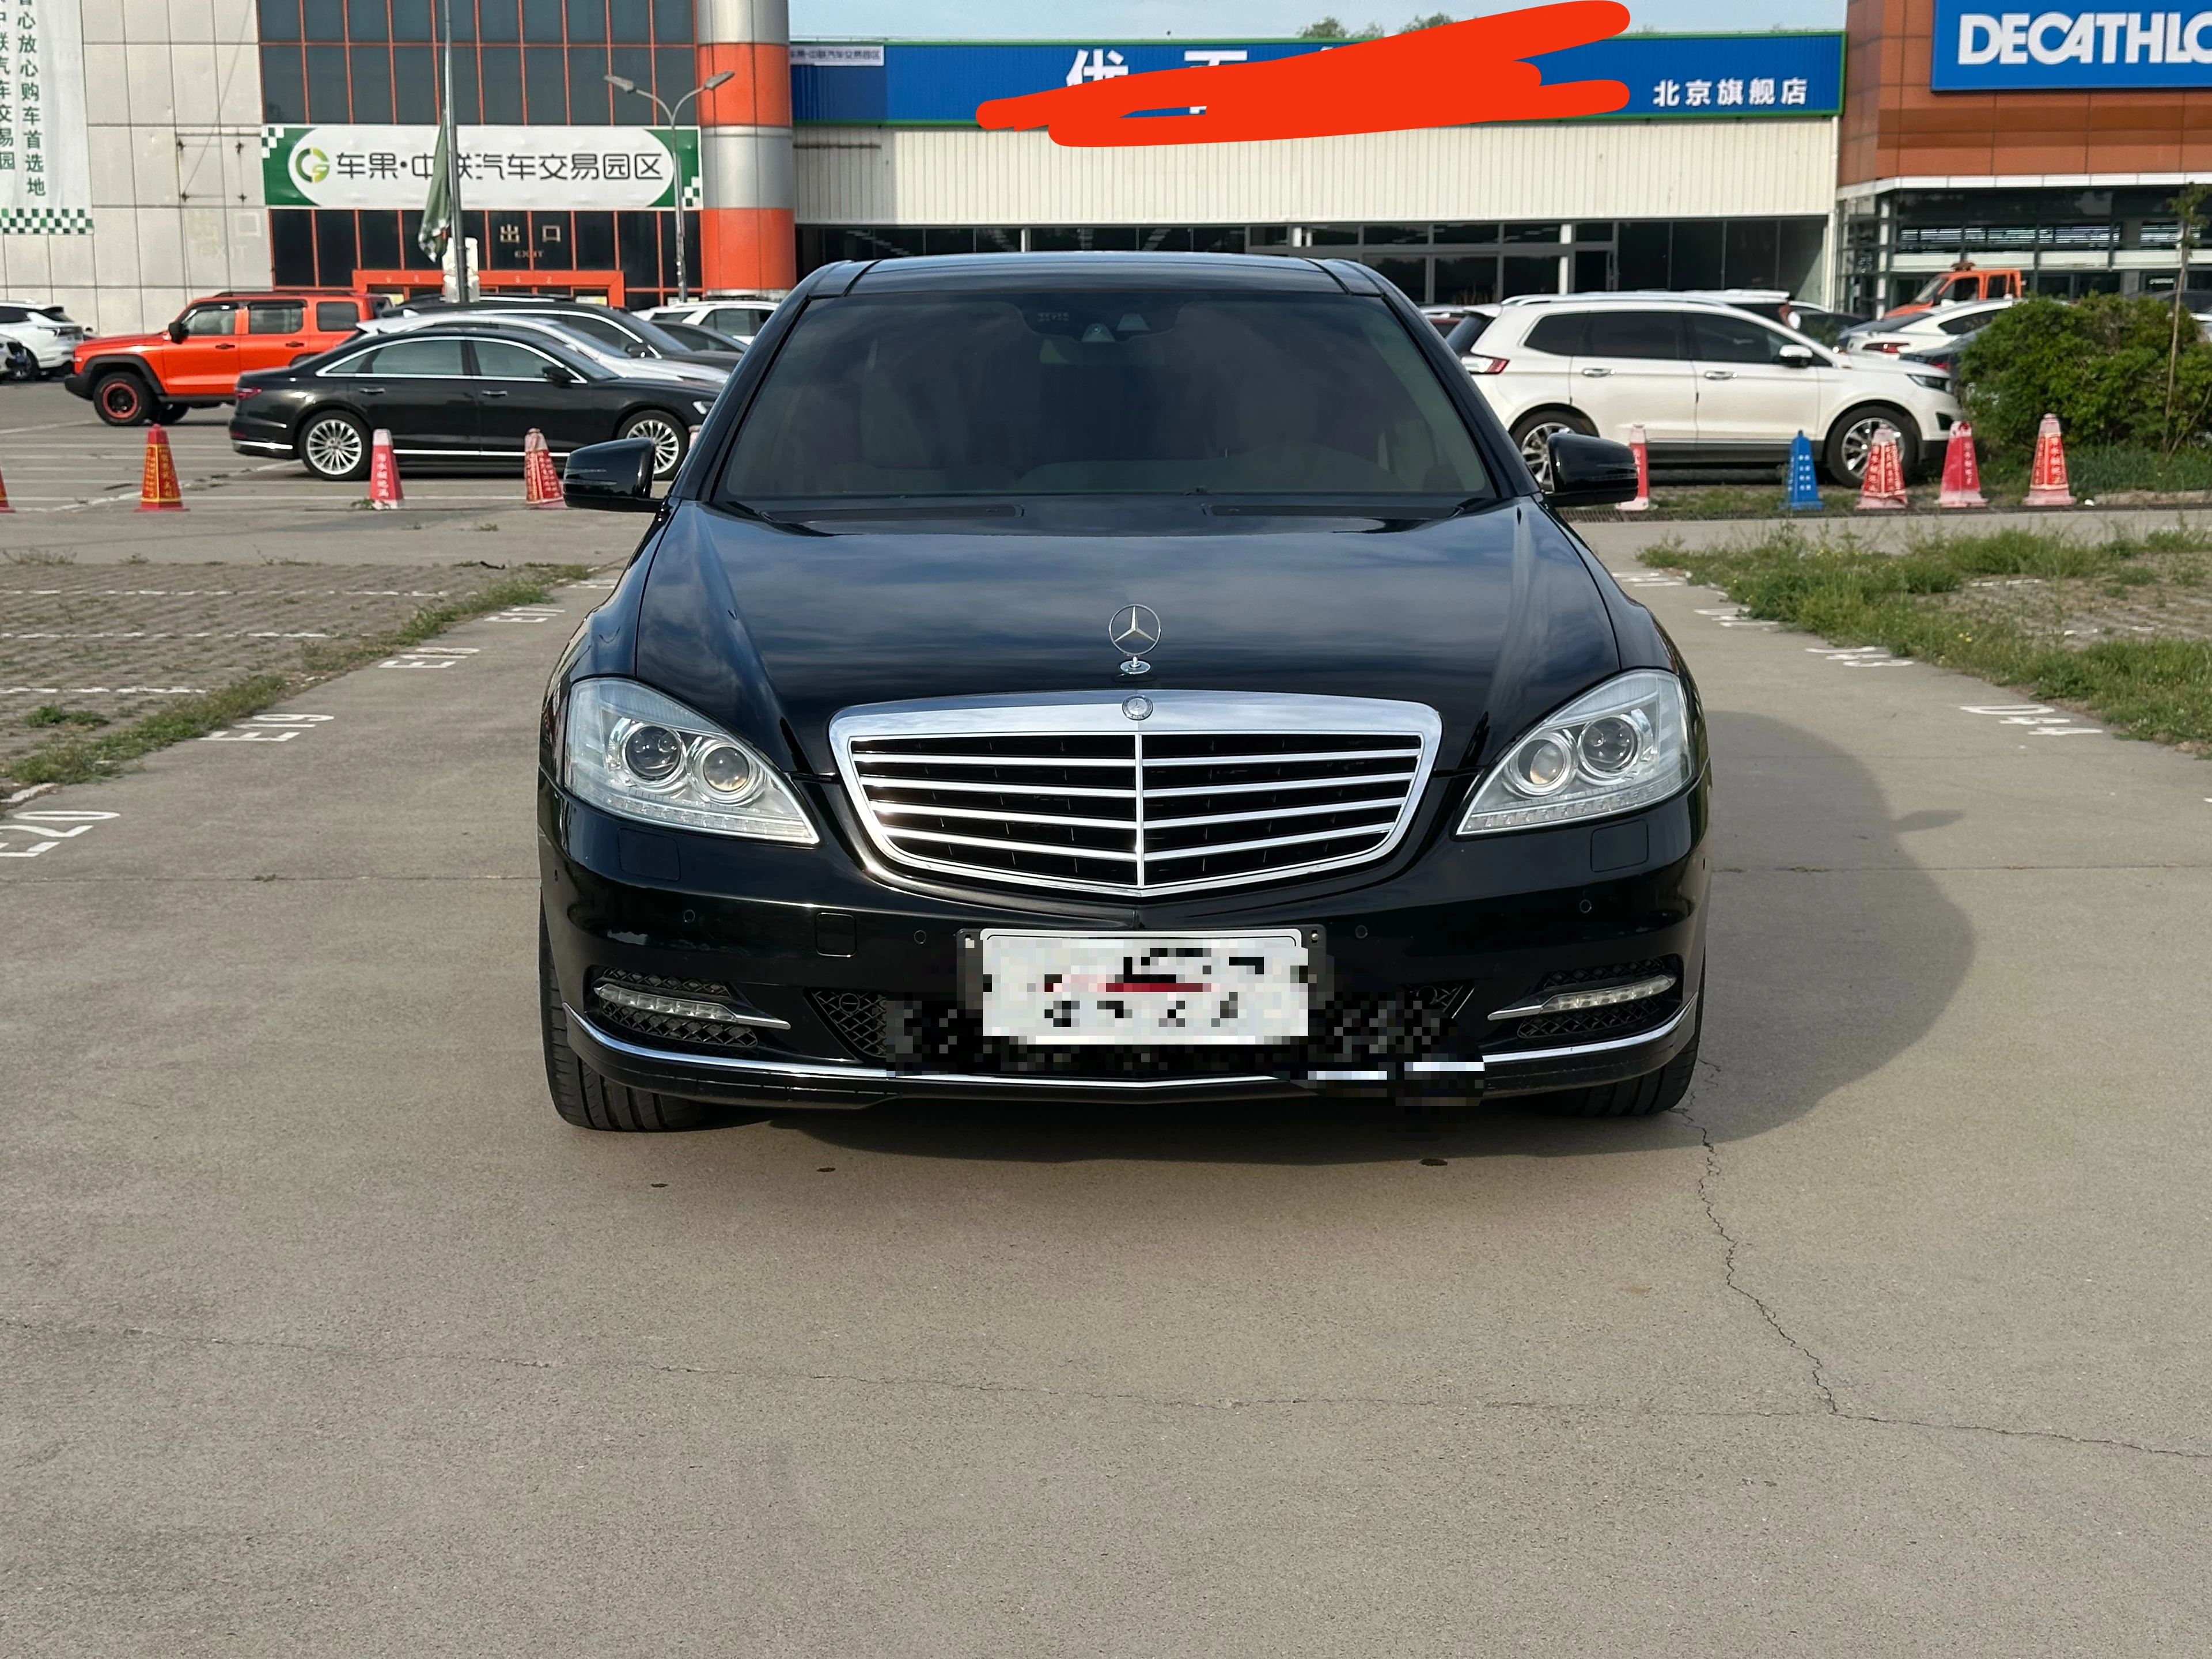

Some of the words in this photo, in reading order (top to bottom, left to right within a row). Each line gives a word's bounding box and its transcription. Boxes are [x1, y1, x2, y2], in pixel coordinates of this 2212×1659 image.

[1652, 77, 1808, 107] 北京旗舰店
[500, 224, 561, 243] 出口
[196, 713, 335, 742] E19
